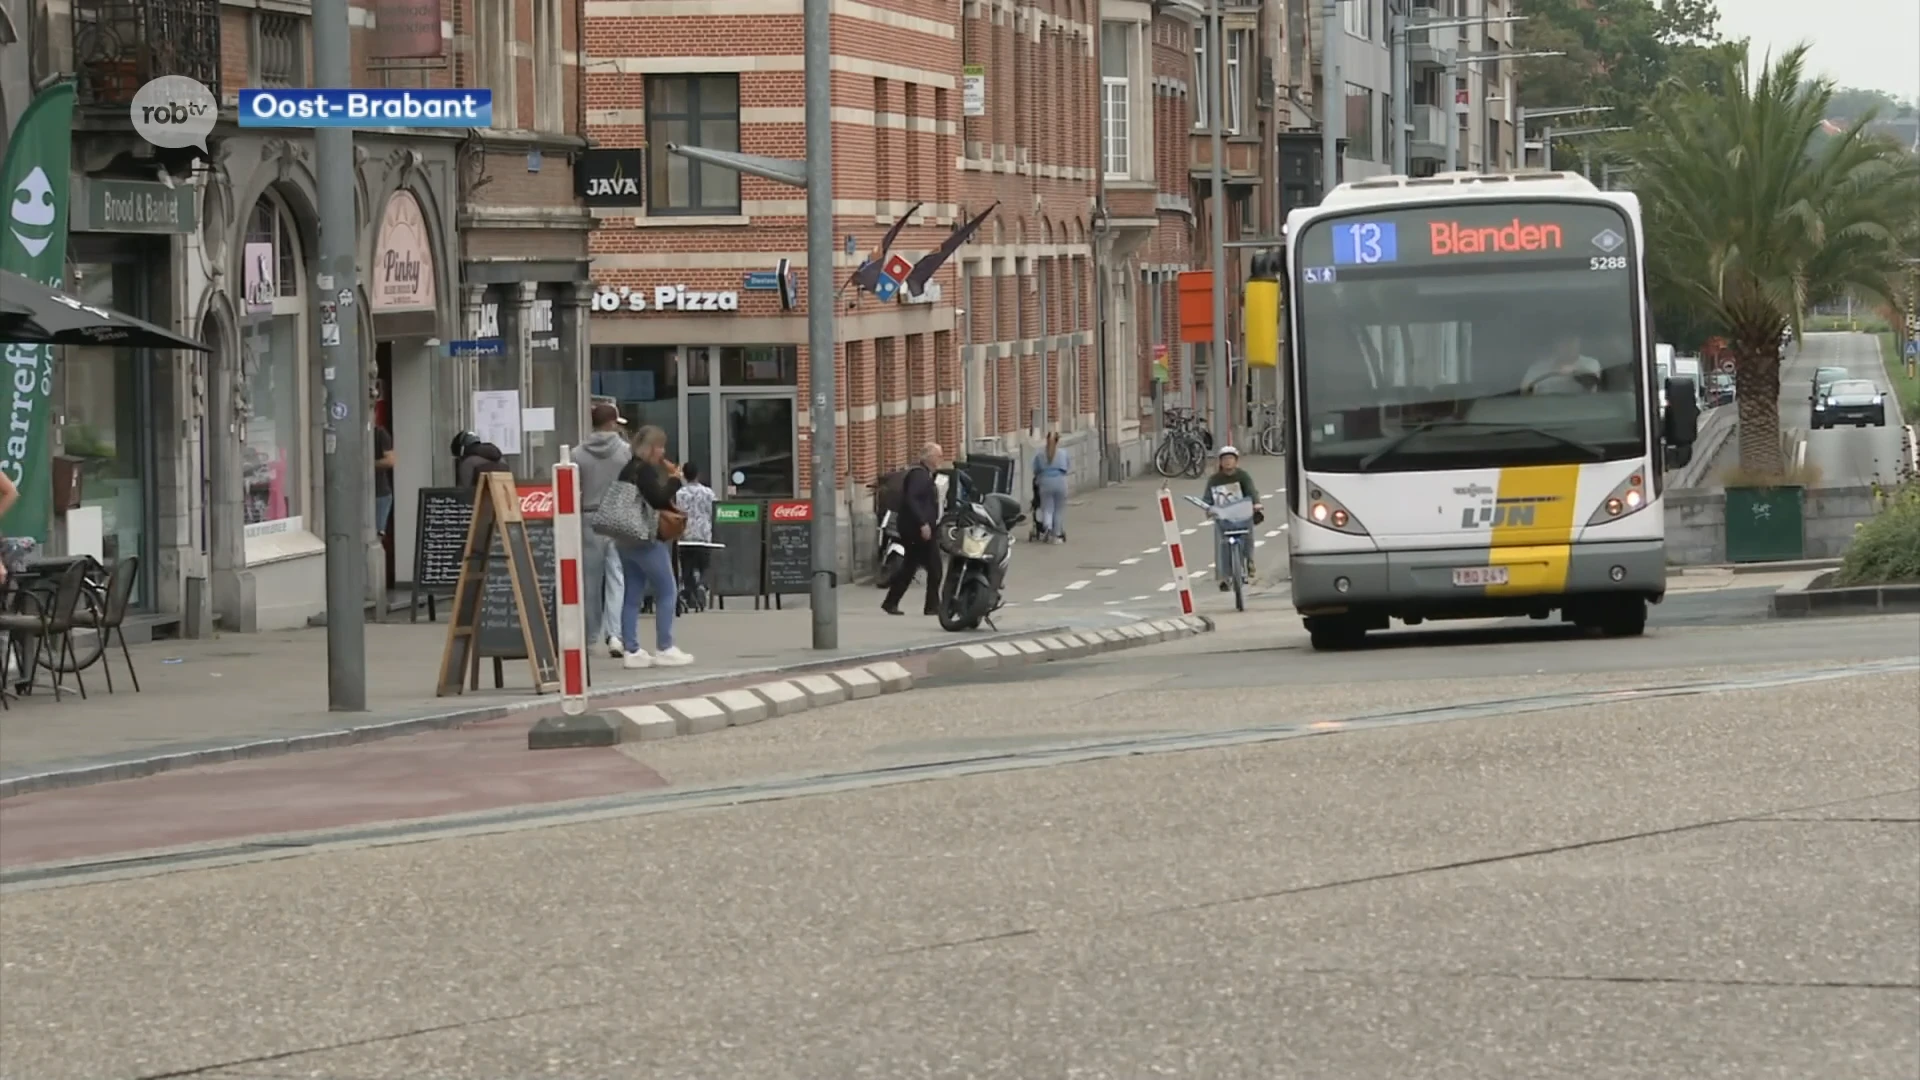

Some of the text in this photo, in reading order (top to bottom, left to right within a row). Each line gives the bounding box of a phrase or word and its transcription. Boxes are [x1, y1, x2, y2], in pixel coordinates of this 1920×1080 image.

[586, 178, 638, 196] JAVA
[104, 191, 134, 222] Brood
[136, 193, 145, 223] &
[1350, 218, 1563, 264] 13 Blanden
[384, 248, 421, 295] Pinky
[1590, 256, 1627, 271] 5288
[654, 283, 738, 312] Pizza
